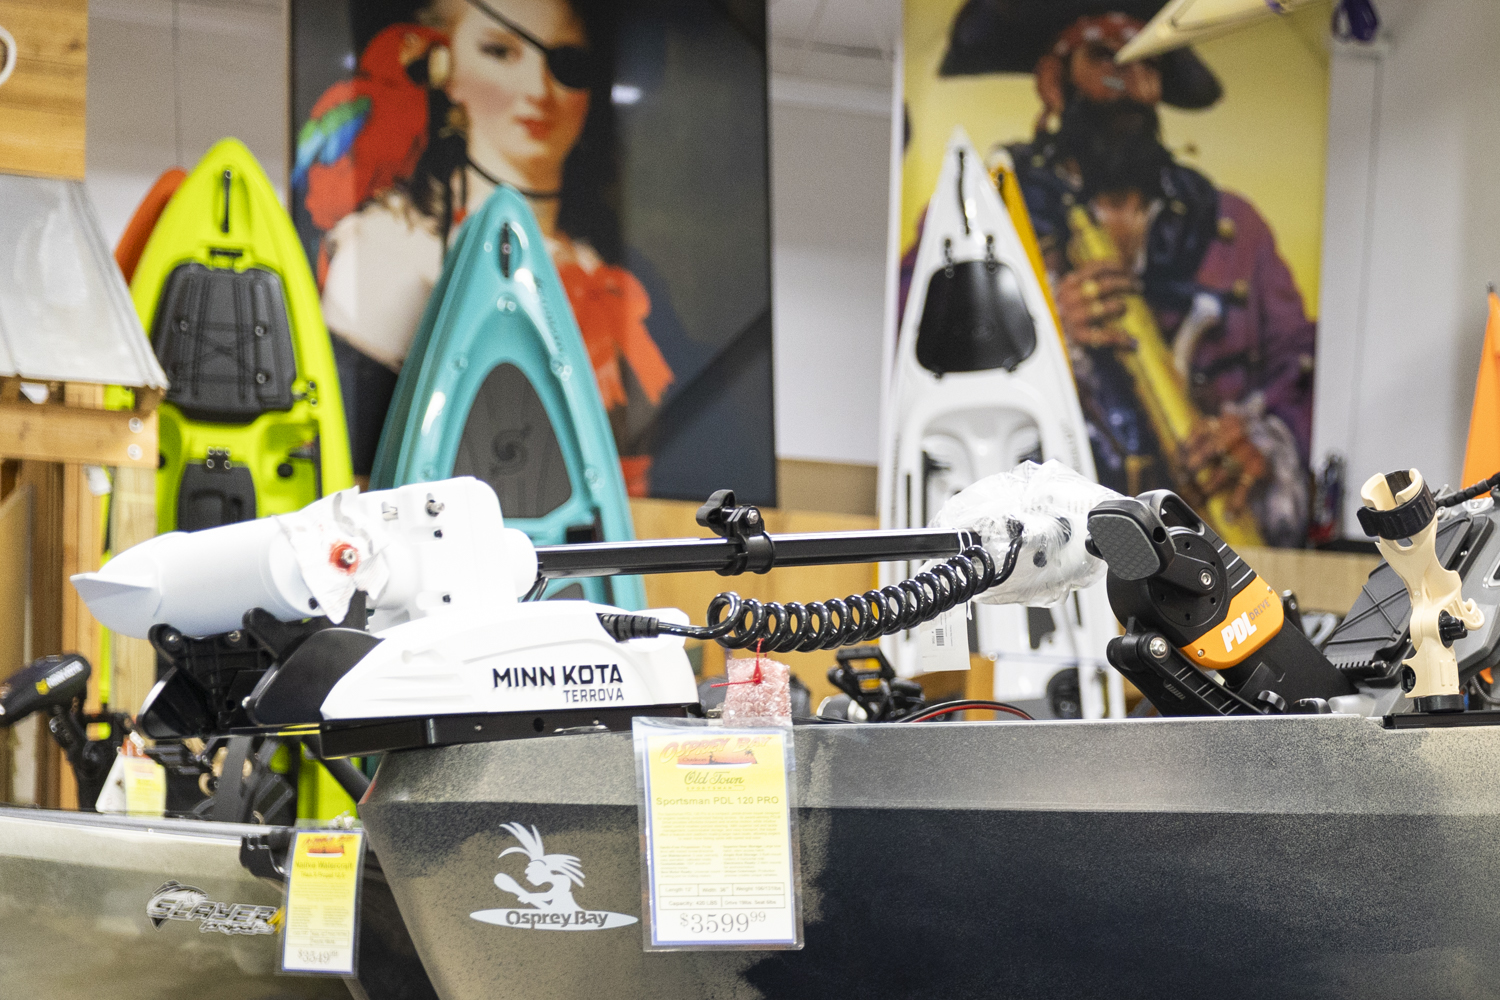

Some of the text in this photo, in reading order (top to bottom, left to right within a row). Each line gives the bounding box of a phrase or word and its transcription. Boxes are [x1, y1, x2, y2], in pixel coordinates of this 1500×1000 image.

[1248, 598, 1271, 621] DRIVE
[1220, 611, 1258, 653] PDL
[492, 664, 624, 688] MINN KOTA
[562, 687, 625, 703] TERROVA
[659, 736, 773, 763] OSPREY BAY
[684, 770, 745, 785] Old Town
[656, 796, 779, 807] Sportsman PDL 120 PRO
[149, 897, 278, 922] SLAYER
[505, 911, 608, 929] Osprey Bay
